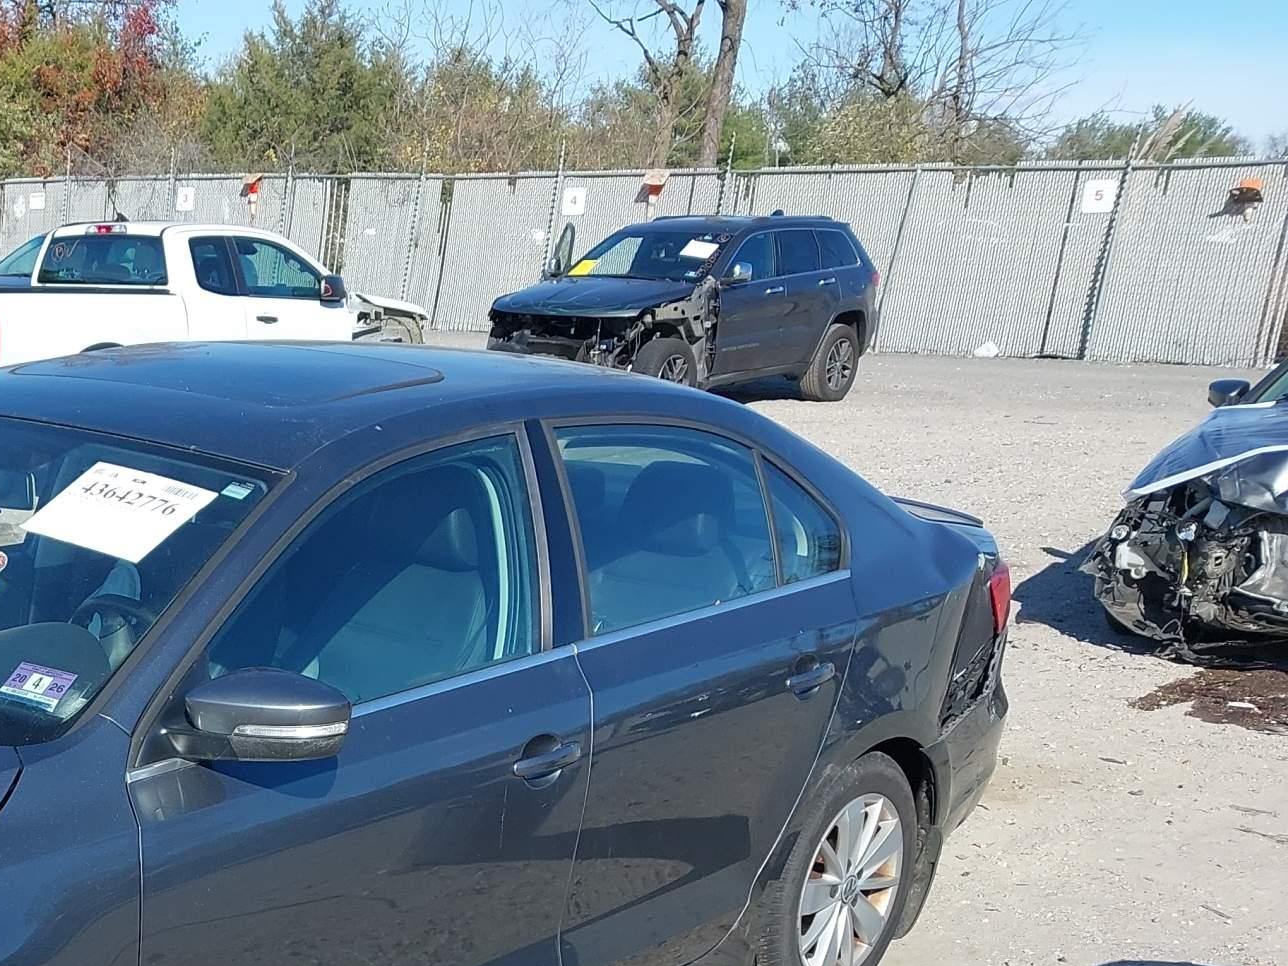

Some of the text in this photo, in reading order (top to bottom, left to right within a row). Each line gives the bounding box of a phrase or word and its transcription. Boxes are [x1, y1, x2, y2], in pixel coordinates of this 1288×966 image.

[1094, 189, 1104, 201] 5
[81, 481, 180, 516] 43642776
[11, 673, 66, 694] 20 4 26
